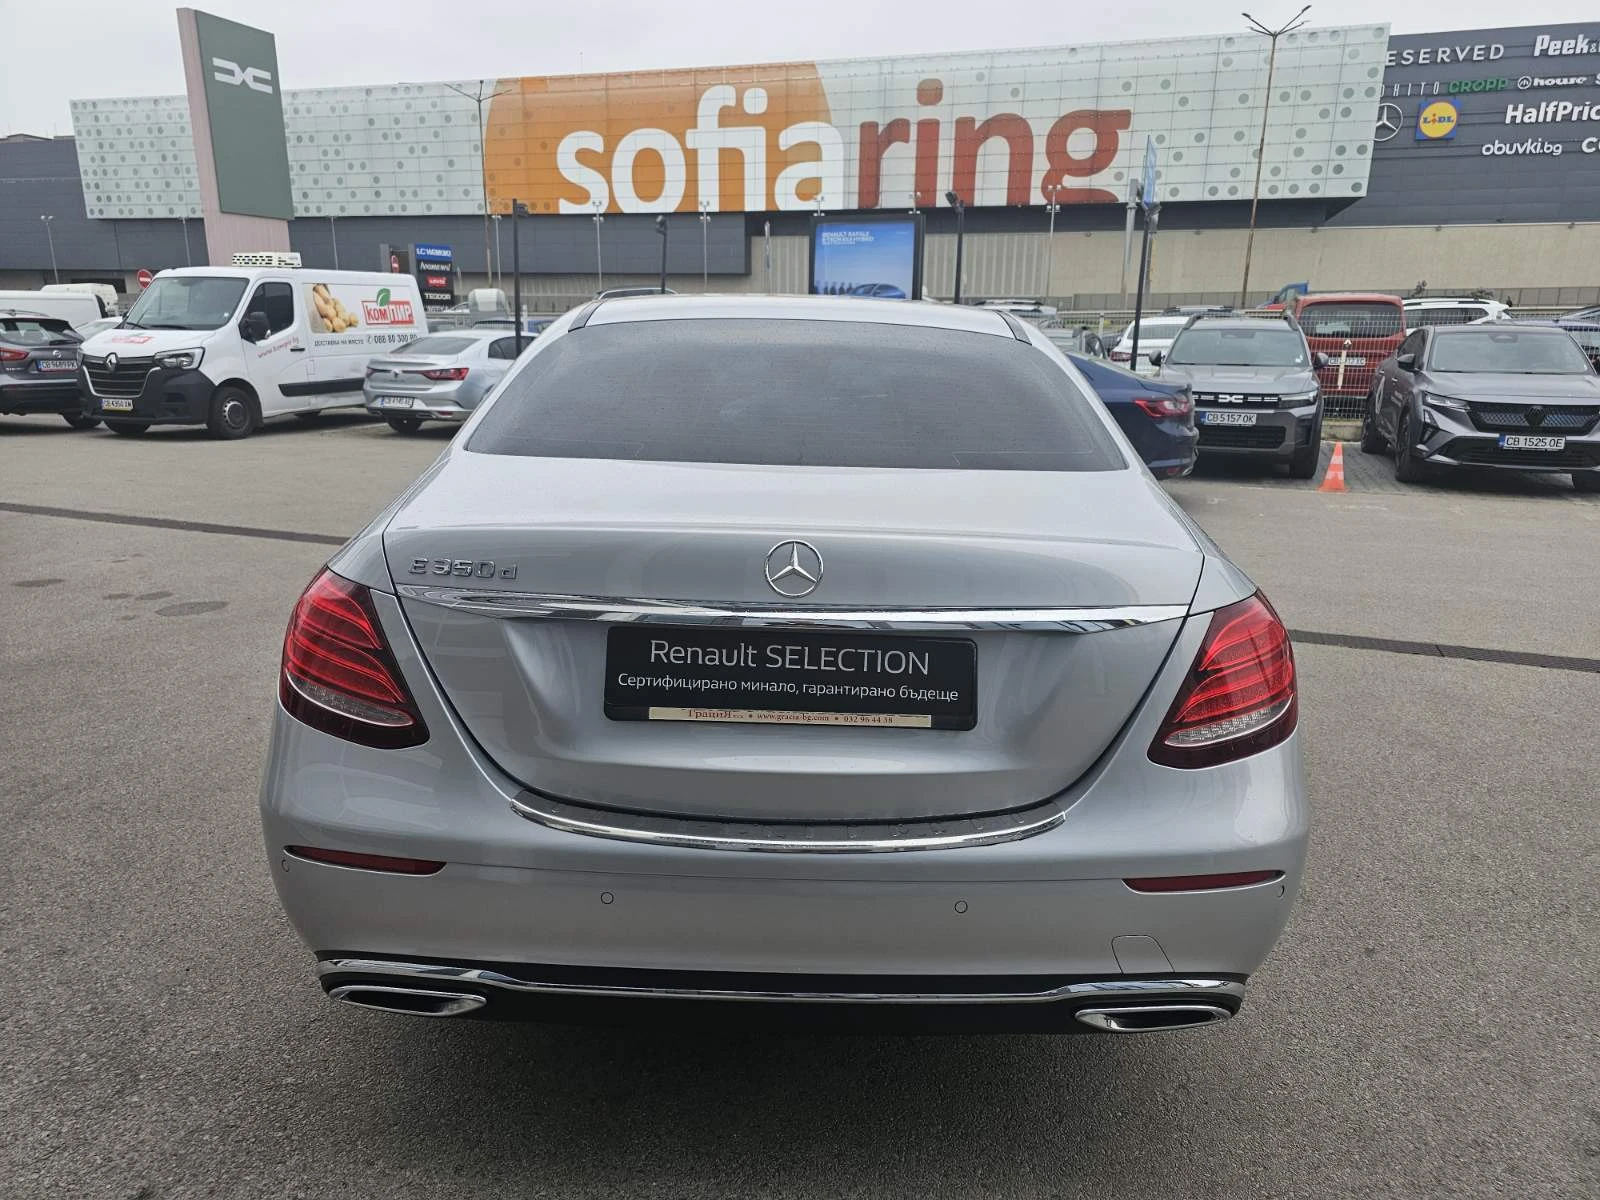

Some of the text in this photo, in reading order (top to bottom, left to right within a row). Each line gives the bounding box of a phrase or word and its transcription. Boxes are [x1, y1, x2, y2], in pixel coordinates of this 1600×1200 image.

[1448, 77, 1508, 94] CROPP
[1482, 137, 1563, 156] obuvki.bg
[650, 640, 929, 676] Renault SELECTION
[618, 673, 959, 702] Сертифицирано минало, гарантирано бъдеще
